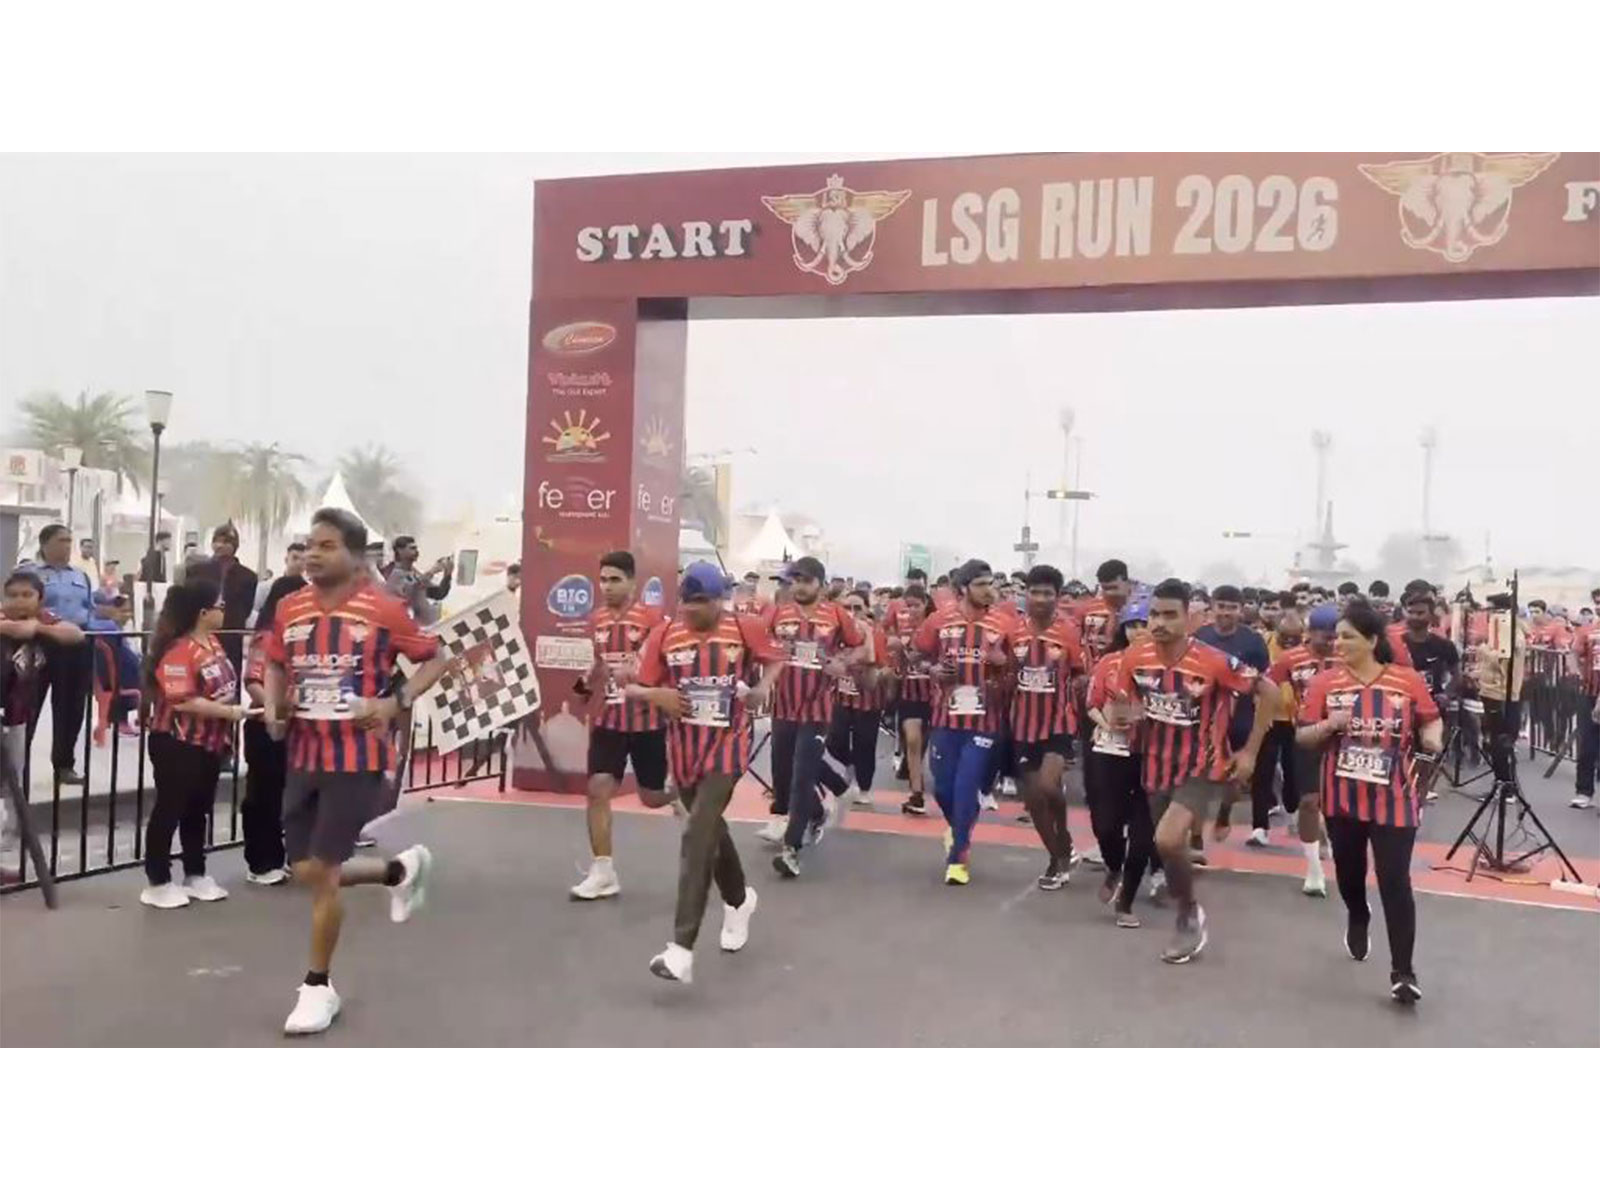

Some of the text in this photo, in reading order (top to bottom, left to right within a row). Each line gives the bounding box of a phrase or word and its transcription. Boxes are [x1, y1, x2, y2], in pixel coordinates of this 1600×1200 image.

[576, 218, 753, 262] START
[921, 174, 1339, 267] LSG RUN 2026
[557, 589, 588, 605] BIG
